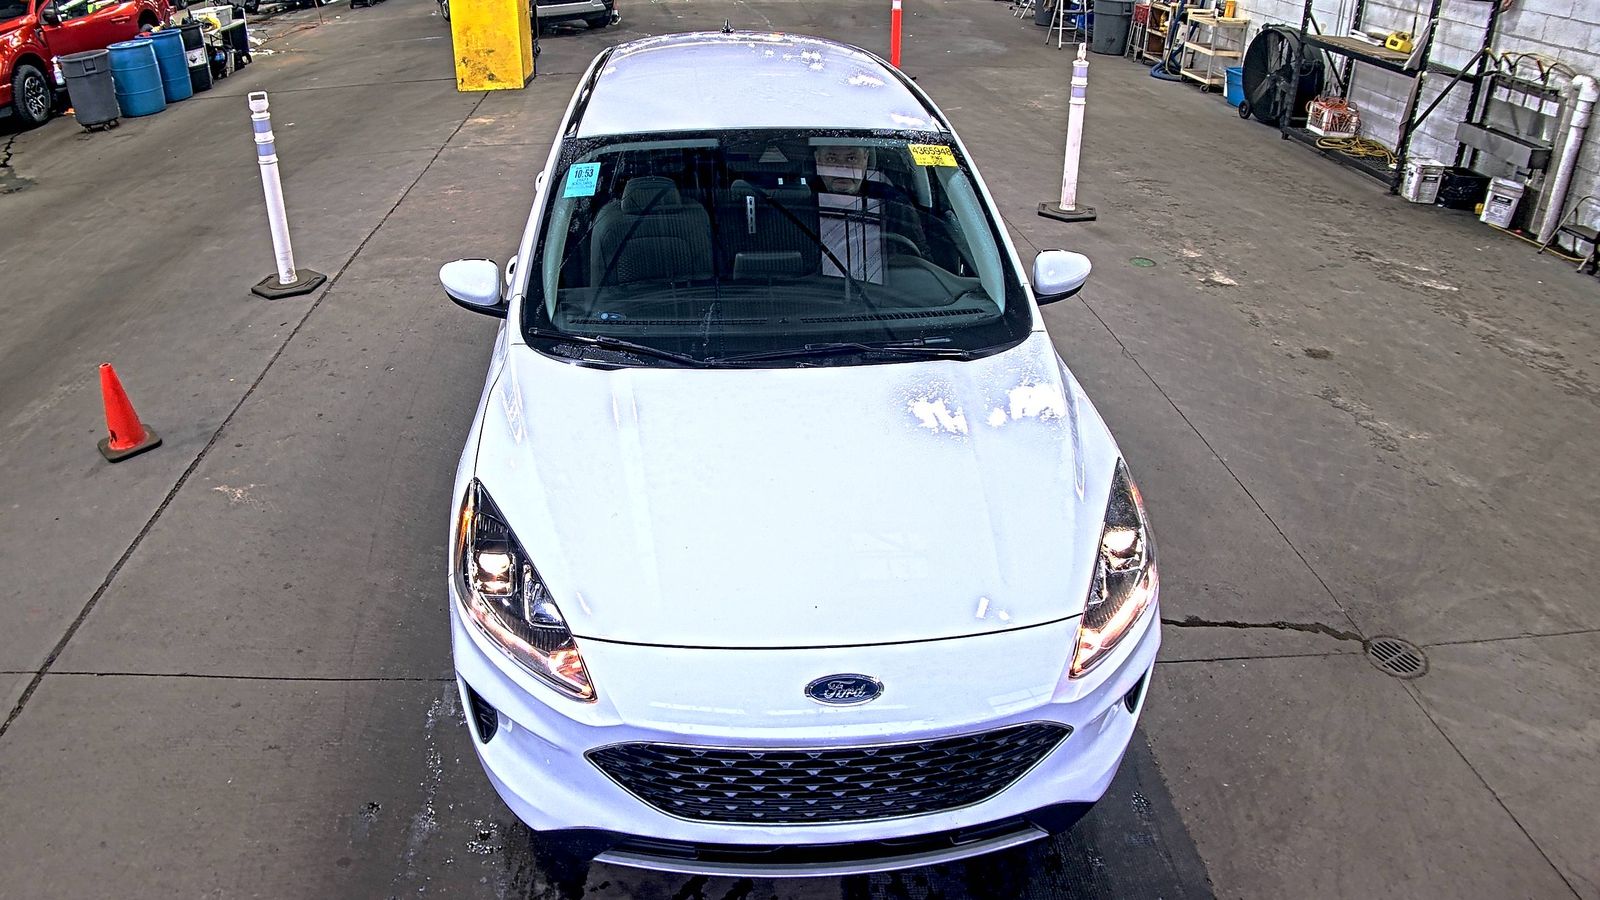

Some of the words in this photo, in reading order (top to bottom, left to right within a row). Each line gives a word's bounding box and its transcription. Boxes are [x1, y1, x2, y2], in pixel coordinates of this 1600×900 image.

[912, 147, 952, 156] 4365948
[574, 169, 594, 178] 10:53
[824, 680, 866, 699] Ford
